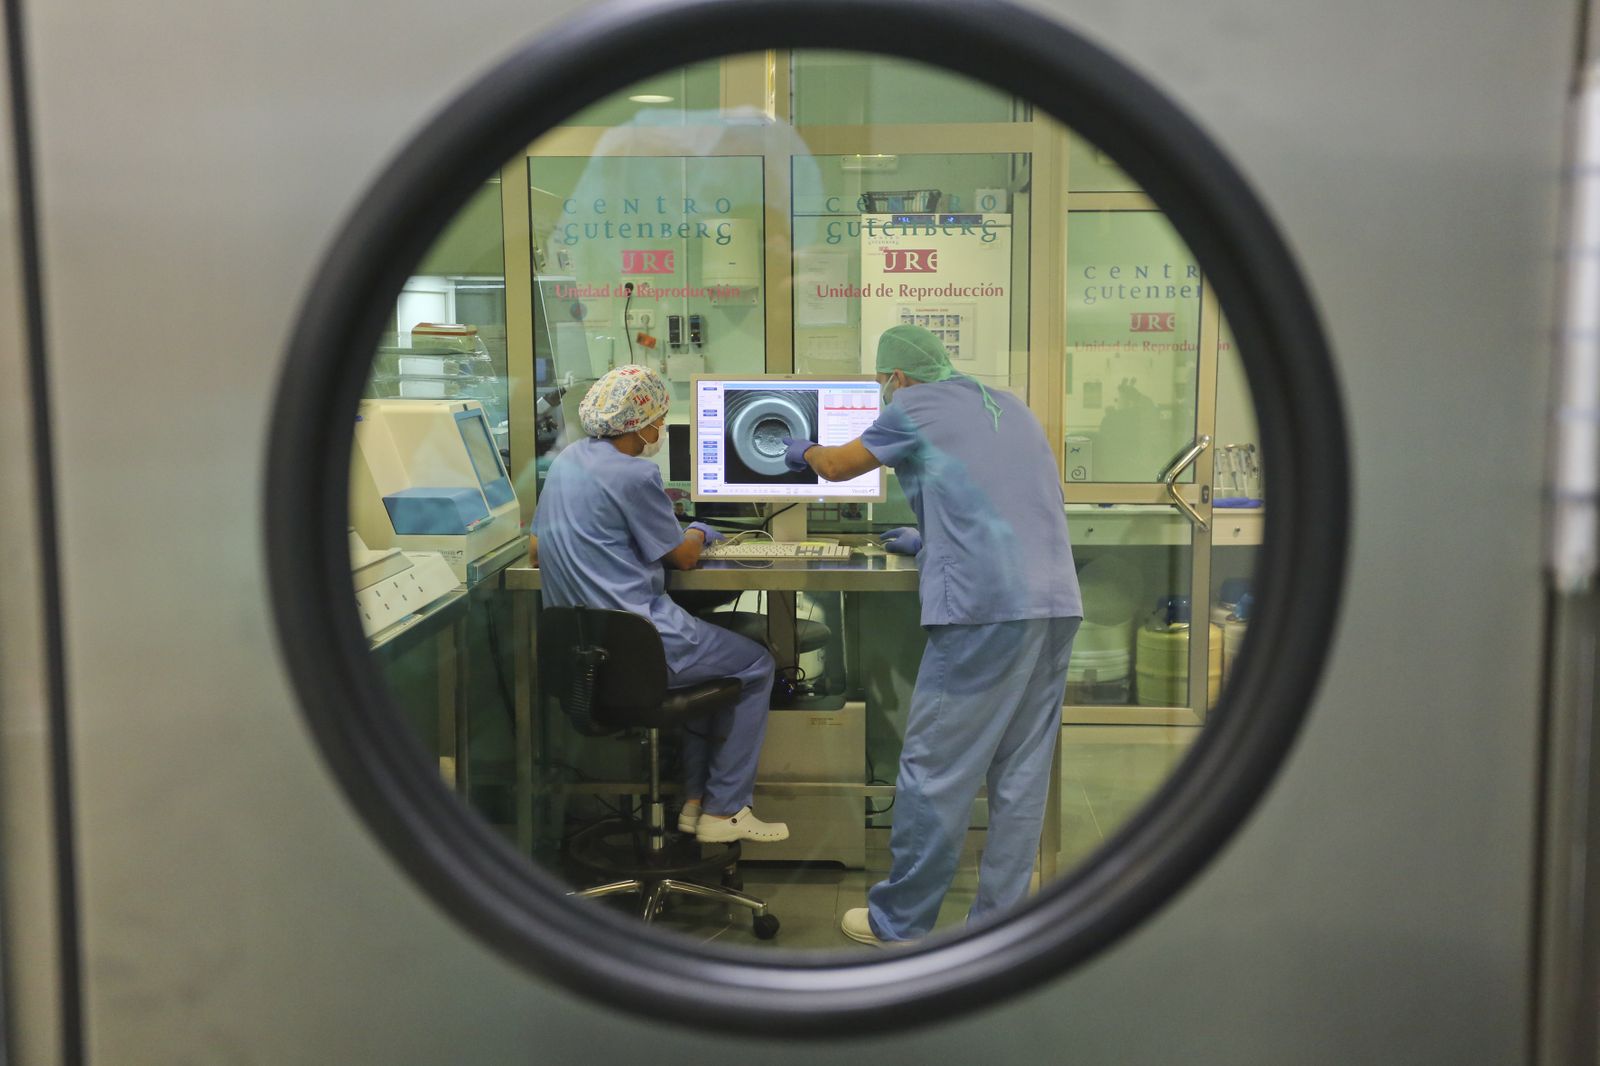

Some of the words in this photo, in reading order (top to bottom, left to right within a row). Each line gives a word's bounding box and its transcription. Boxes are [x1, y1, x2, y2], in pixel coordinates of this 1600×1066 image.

[555, 283, 610, 298] Unidad
[614, 283, 632, 298] de
[636, 283, 740, 301] Reproducción
[817, 283, 871, 298] Unidad
[875, 283, 893, 298] de
[899, 283, 1004, 301] Reproducción
